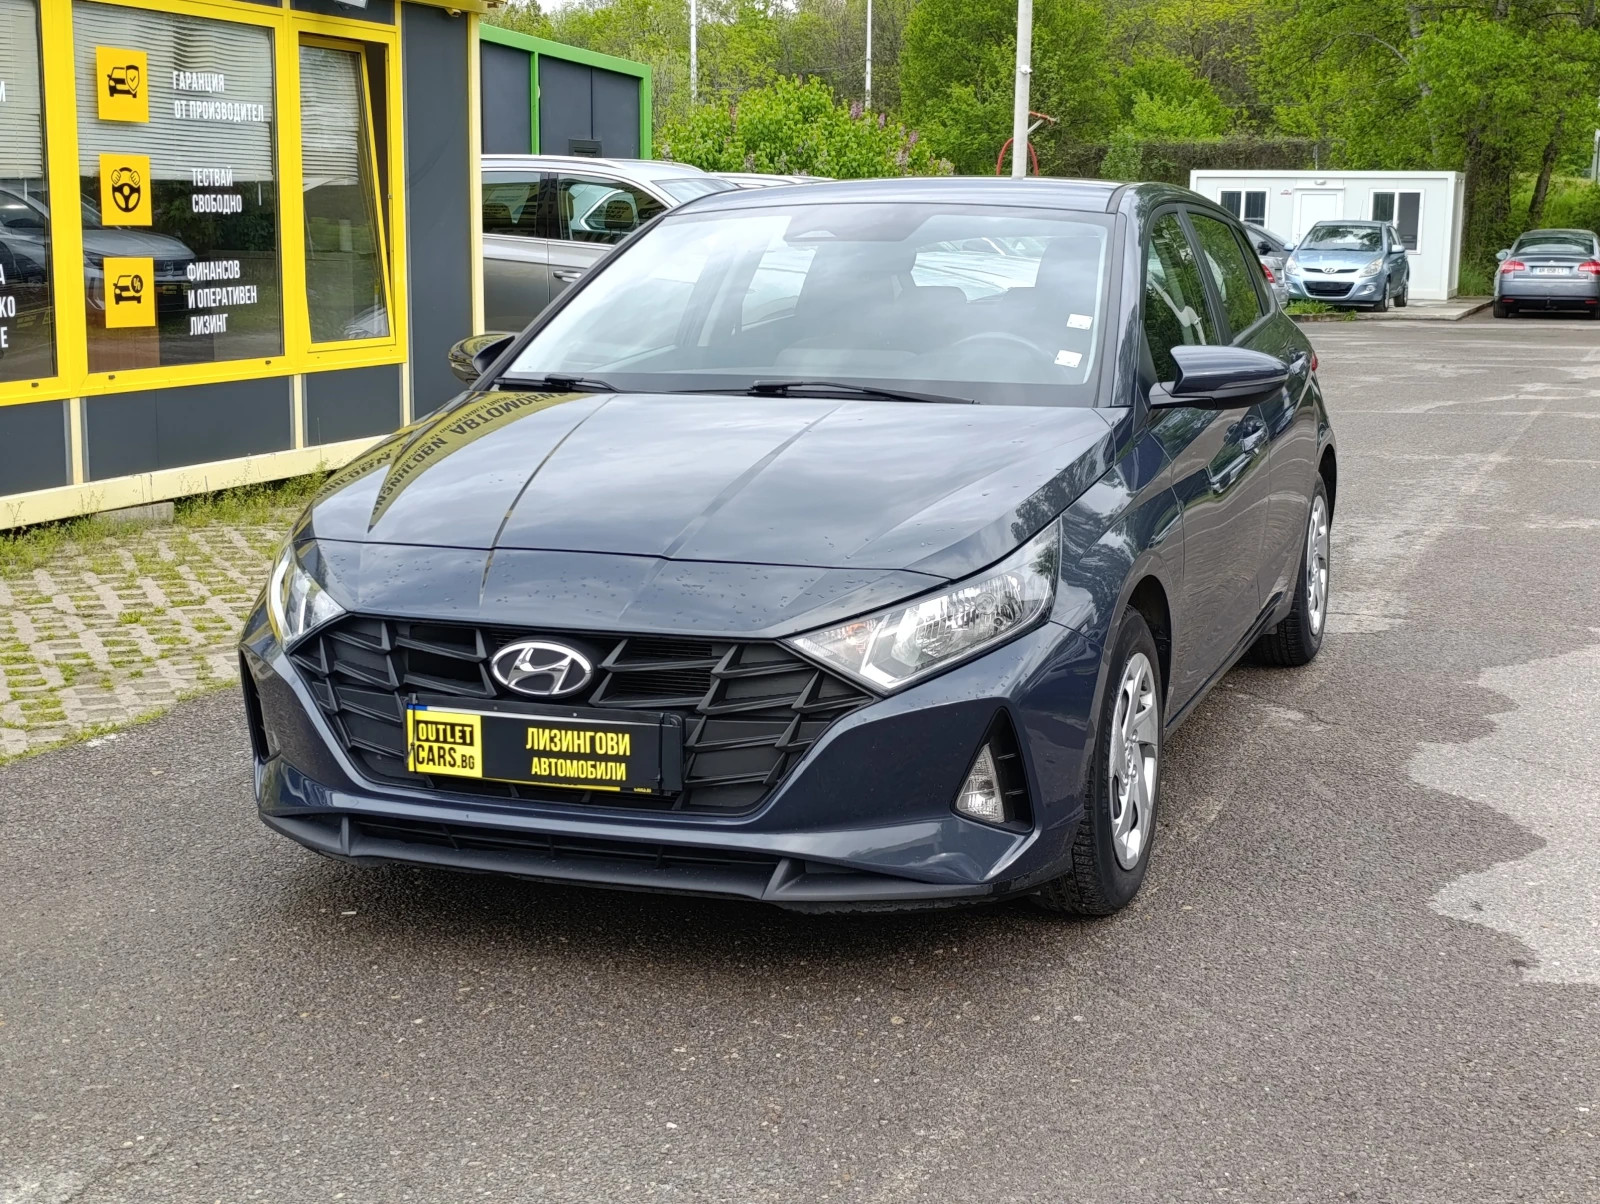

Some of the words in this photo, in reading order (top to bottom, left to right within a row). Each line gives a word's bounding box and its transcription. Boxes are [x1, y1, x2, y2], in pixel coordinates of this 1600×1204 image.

[173, 71, 225, 93] ГАРАНЦИЯ
[174, 100, 186, 119] ОТ
[189, 101, 264, 122] ПРОИЗВОДИТЕЛ
[191, 165, 233, 187] ТЕСТВАЙ
[192, 194, 243, 215] СВОБОДНО
[187, 260, 241, 282] ФИНАНСОВ
[187, 290, 196, 309] И
[197, 285, 257, 308] ОПЕРАТИВЕН
[190, 313, 229, 336] ЛИЗИНГ
[418, 724, 473, 743] OUTLET
[526, 727, 631, 756] ЛИЗИНГОВИ
[416, 744, 476, 770] CARS.BG
[531, 757, 627, 781] АВТОМОБИЛИ
